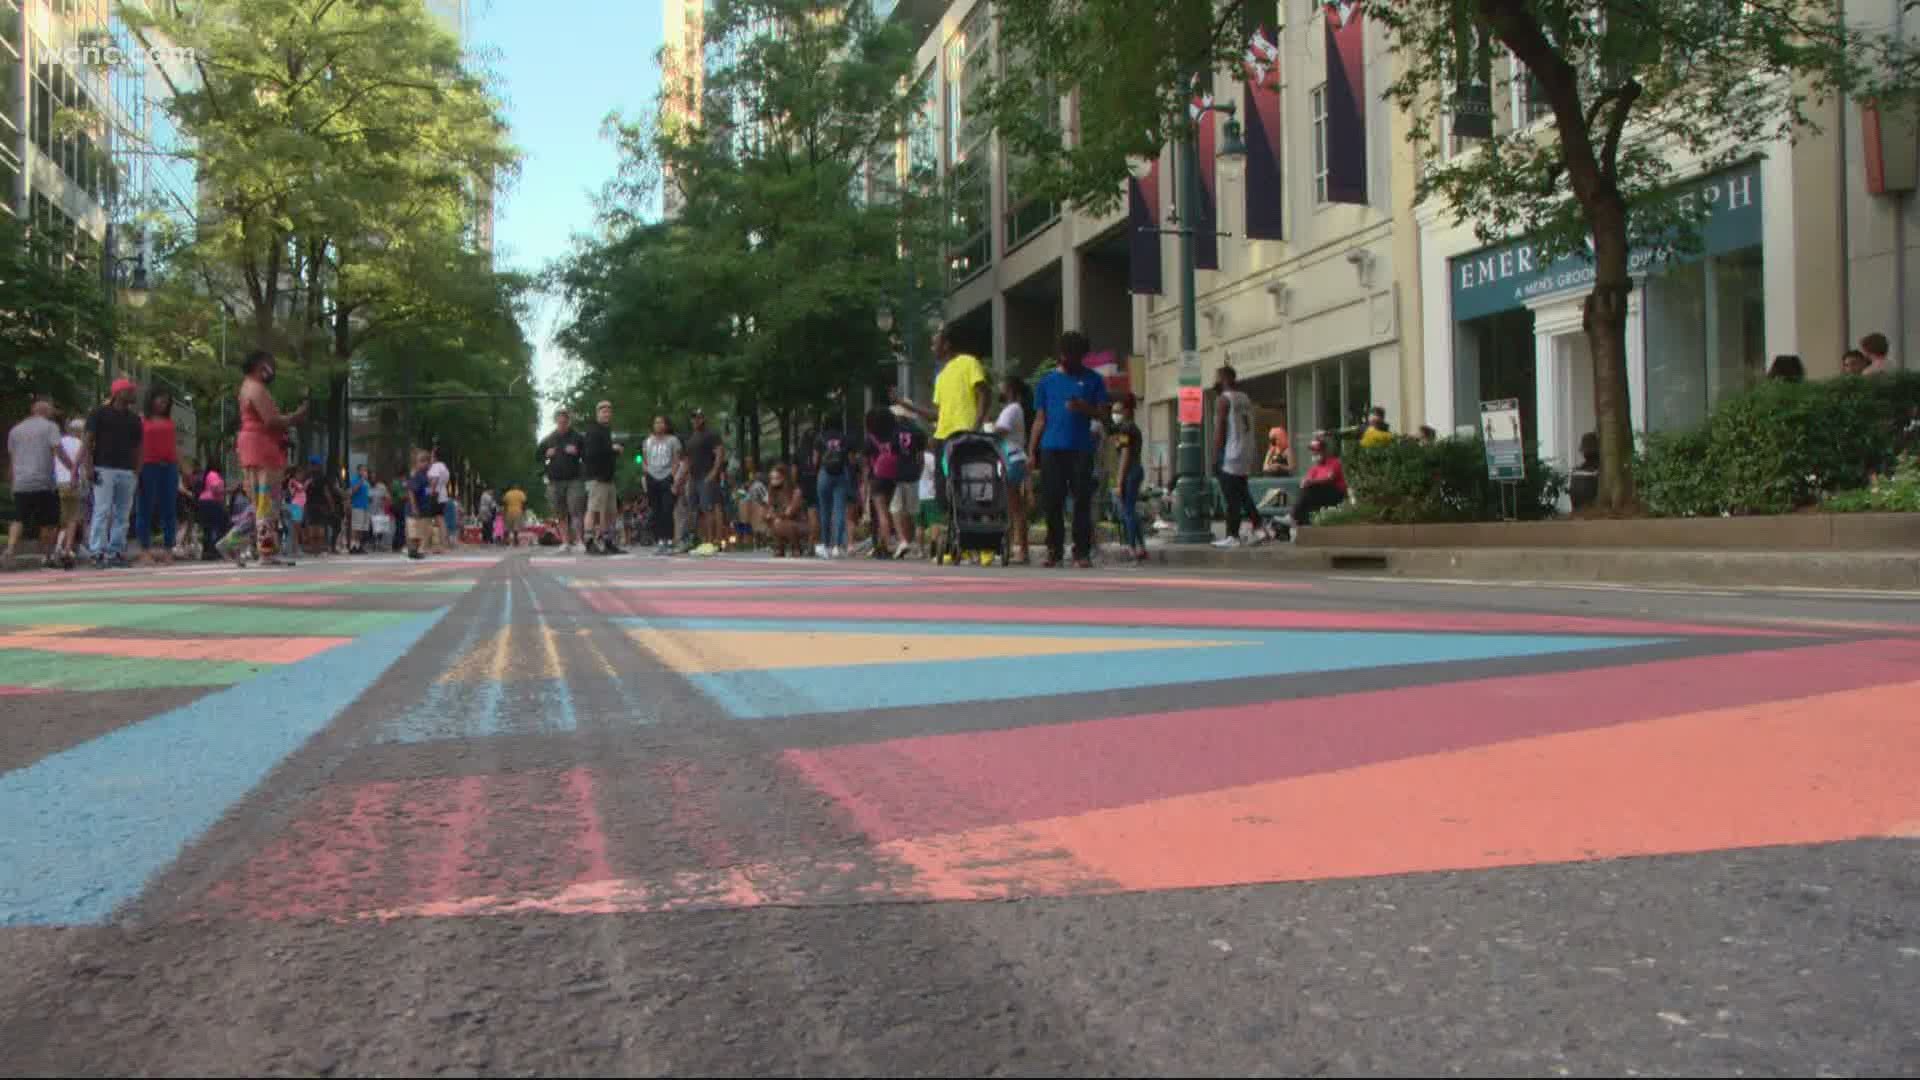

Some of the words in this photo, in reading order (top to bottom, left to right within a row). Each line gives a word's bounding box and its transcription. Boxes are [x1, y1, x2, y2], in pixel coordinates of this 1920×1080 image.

[1460, 232, 1596, 289] EMER
[1514, 287, 1523, 298] A
[1557, 266, 1597, 288] GROO
